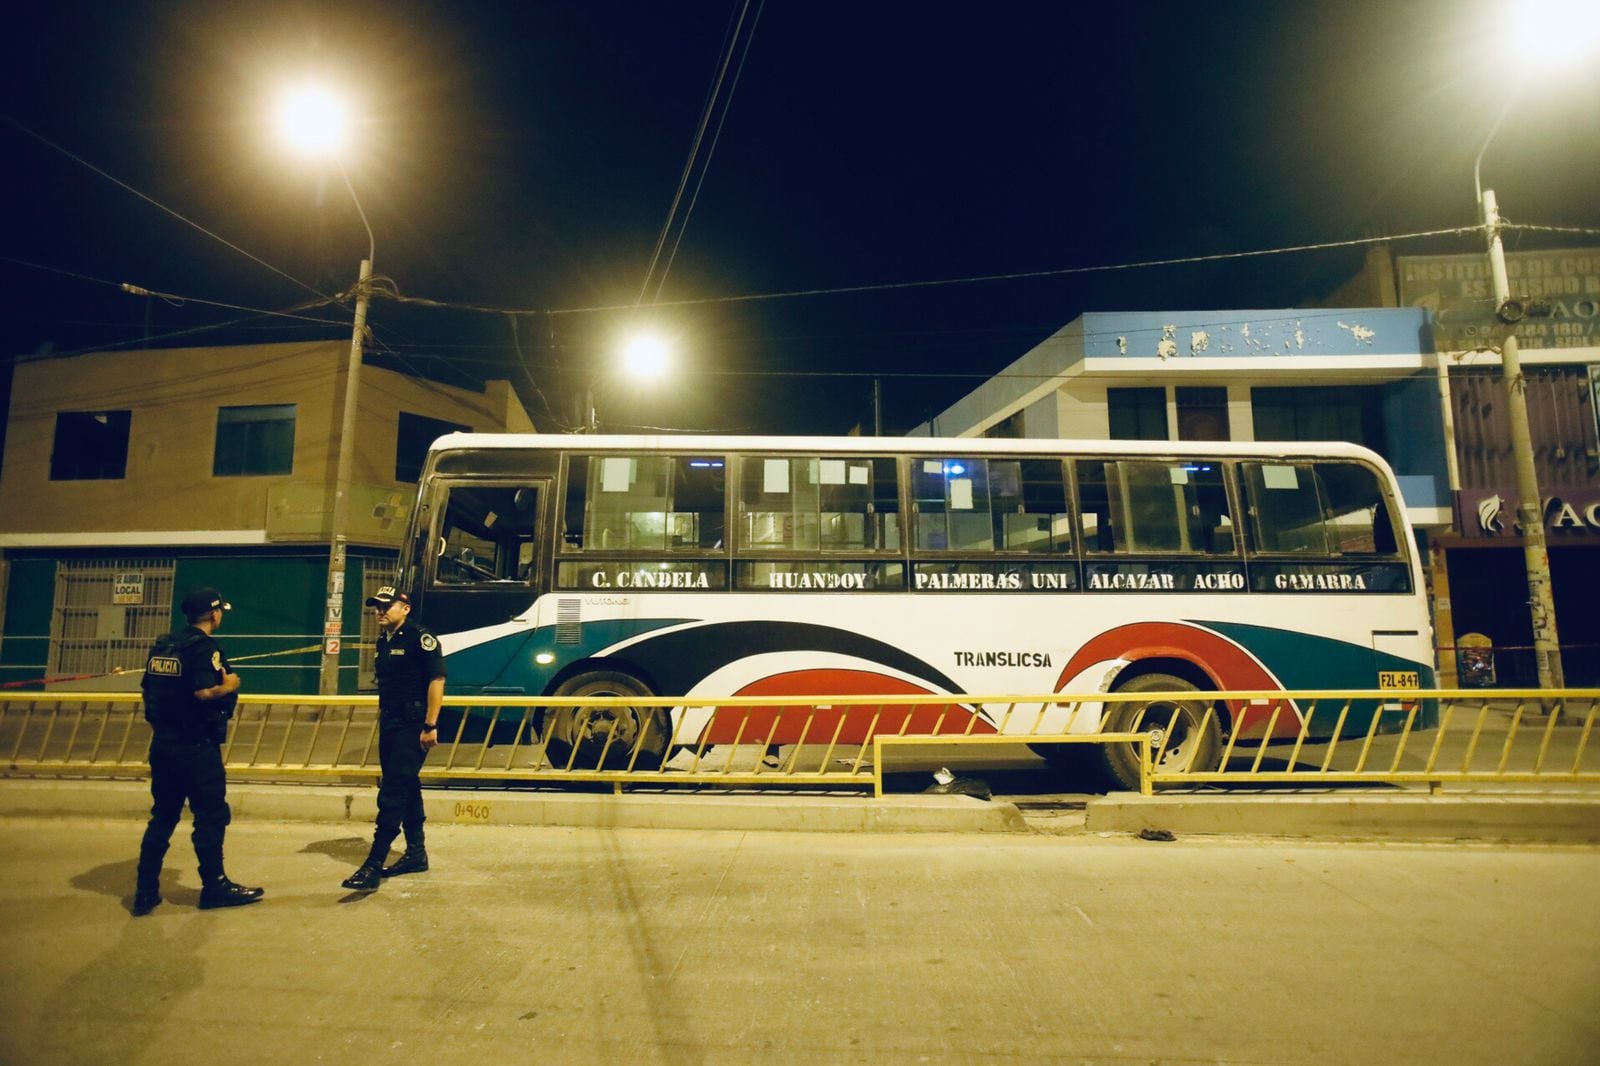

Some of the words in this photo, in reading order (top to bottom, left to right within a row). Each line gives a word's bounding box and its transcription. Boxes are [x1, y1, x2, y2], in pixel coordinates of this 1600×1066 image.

[593, 571, 611, 588] C.
[617, 571, 709, 588] CANDELA
[769, 572, 867, 589] HUANDOY
[915, 573, 1021, 589] PALMERAS
[1032, 573, 1067, 589] UNI
[1089, 574, 1174, 589] ALCAZAR
[1194, 574, 1244, 589] ACHO
[1275, 574, 1366, 590] GAMARRA
[115, 586, 141, 595] LOCAL
[329, 641, 339, 653] 2
[151, 658, 178, 674] POLICIA
[954, 651, 1052, 668] TRANSLICSA
[1381, 673, 1419, 688] F2L-847
